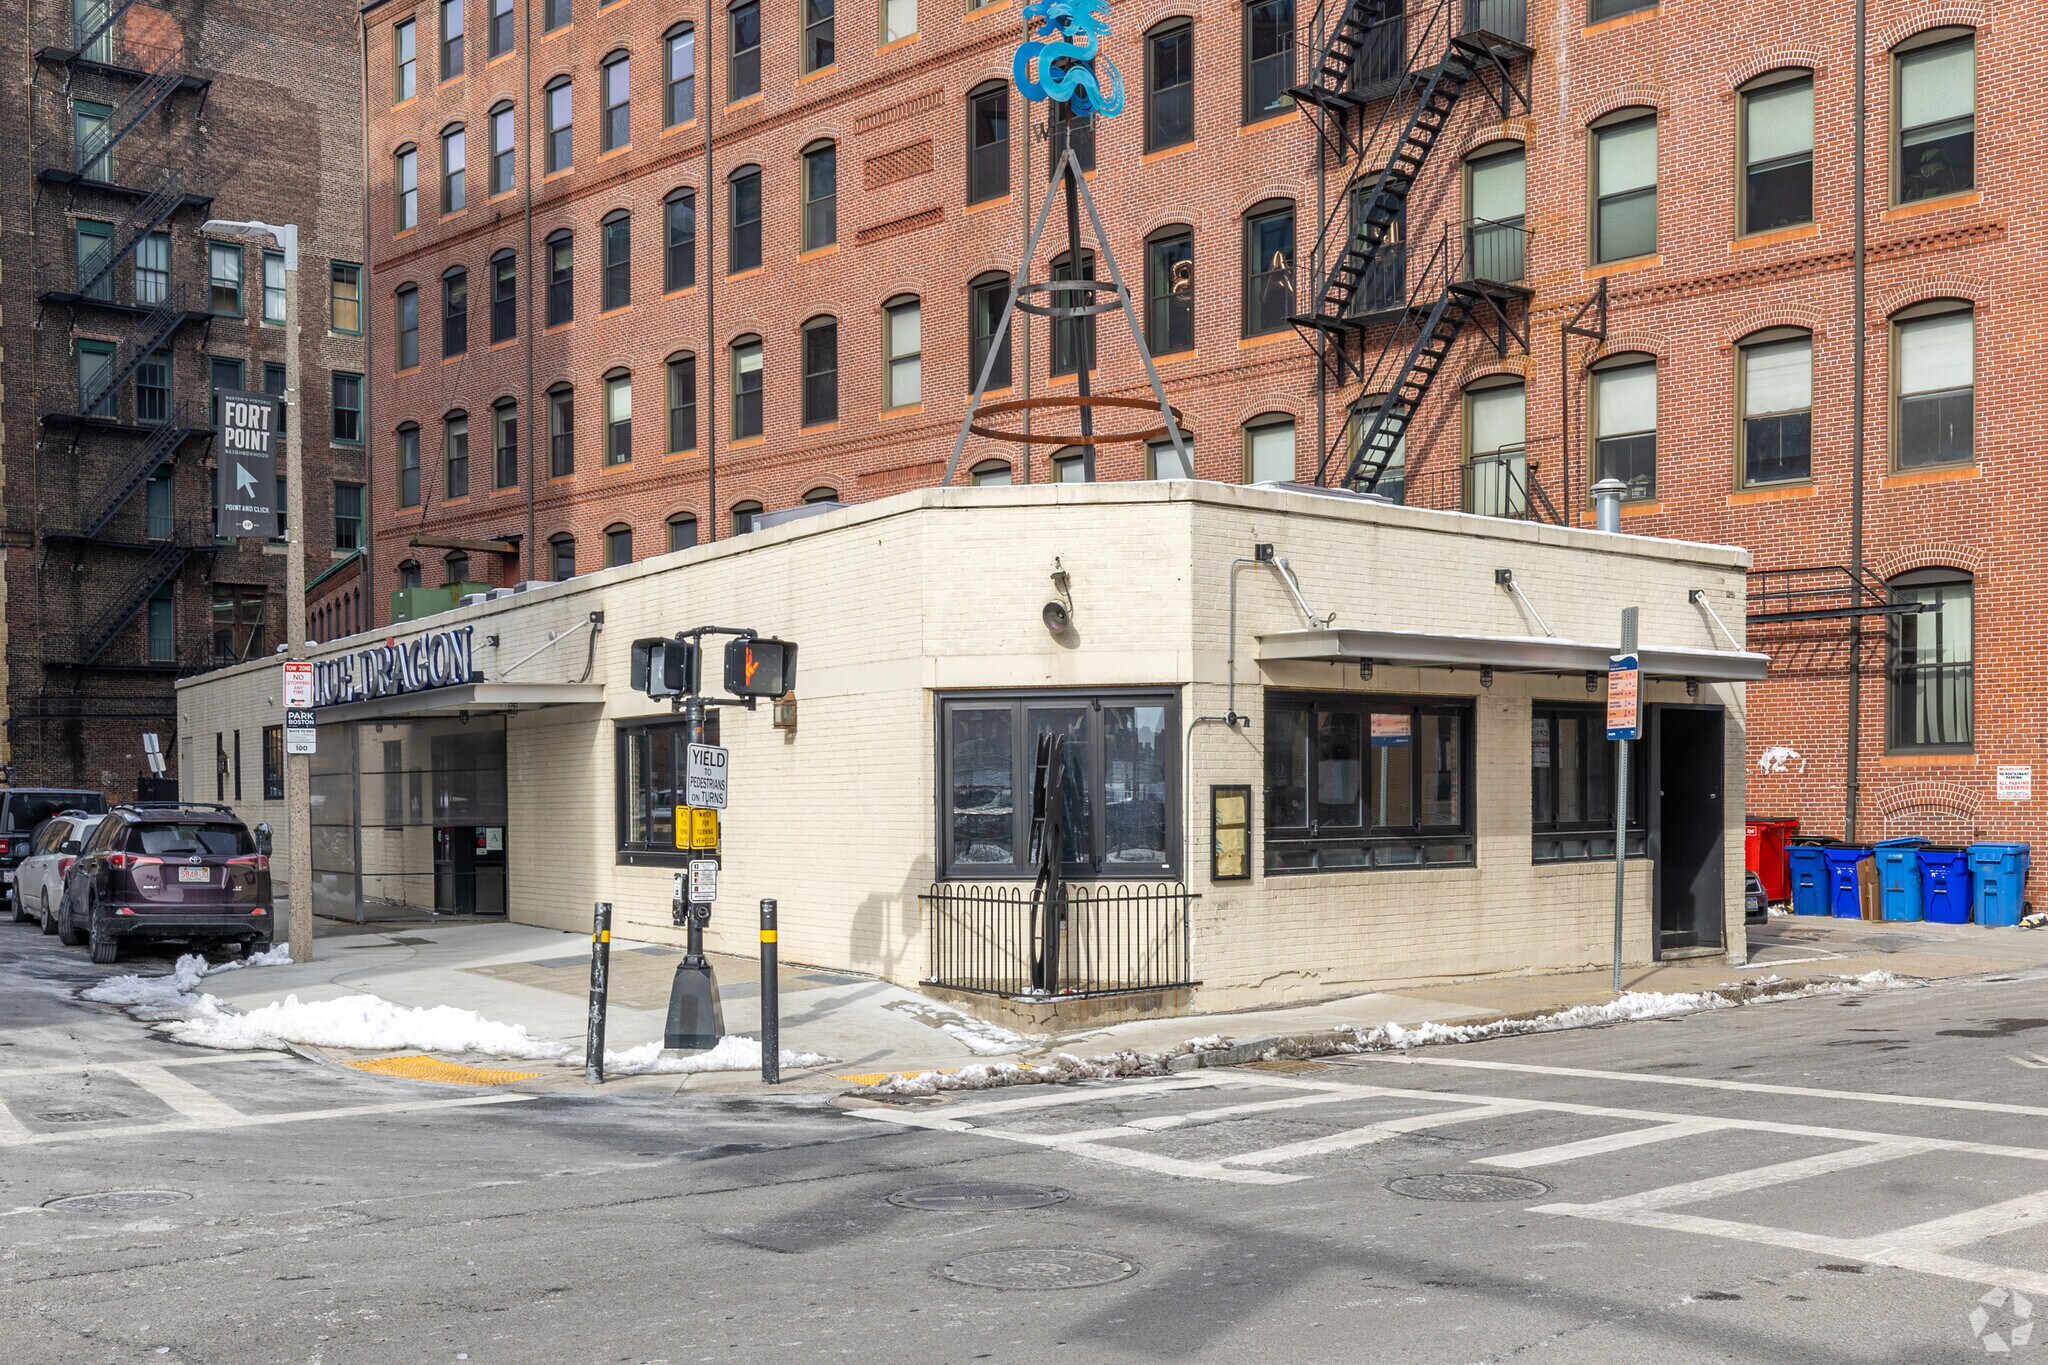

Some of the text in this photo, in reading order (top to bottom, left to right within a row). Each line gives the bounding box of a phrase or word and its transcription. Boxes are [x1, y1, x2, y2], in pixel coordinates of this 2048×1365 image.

[225, 401, 271, 430] FORT
[225, 427, 270, 451] POINT
[225, 449, 269, 458] NEIGHBORHOOD
[225, 503, 241, 511] POINT
[357, 625, 474, 701] DRAGON
[288, 711, 314, 720] PARK
[692, 749, 725, 767] YIELD
[704, 767, 712, 776] TO
[690, 776, 725, 791] PEDESTRIANS
[691, 791, 724, 804] ON TURNS
